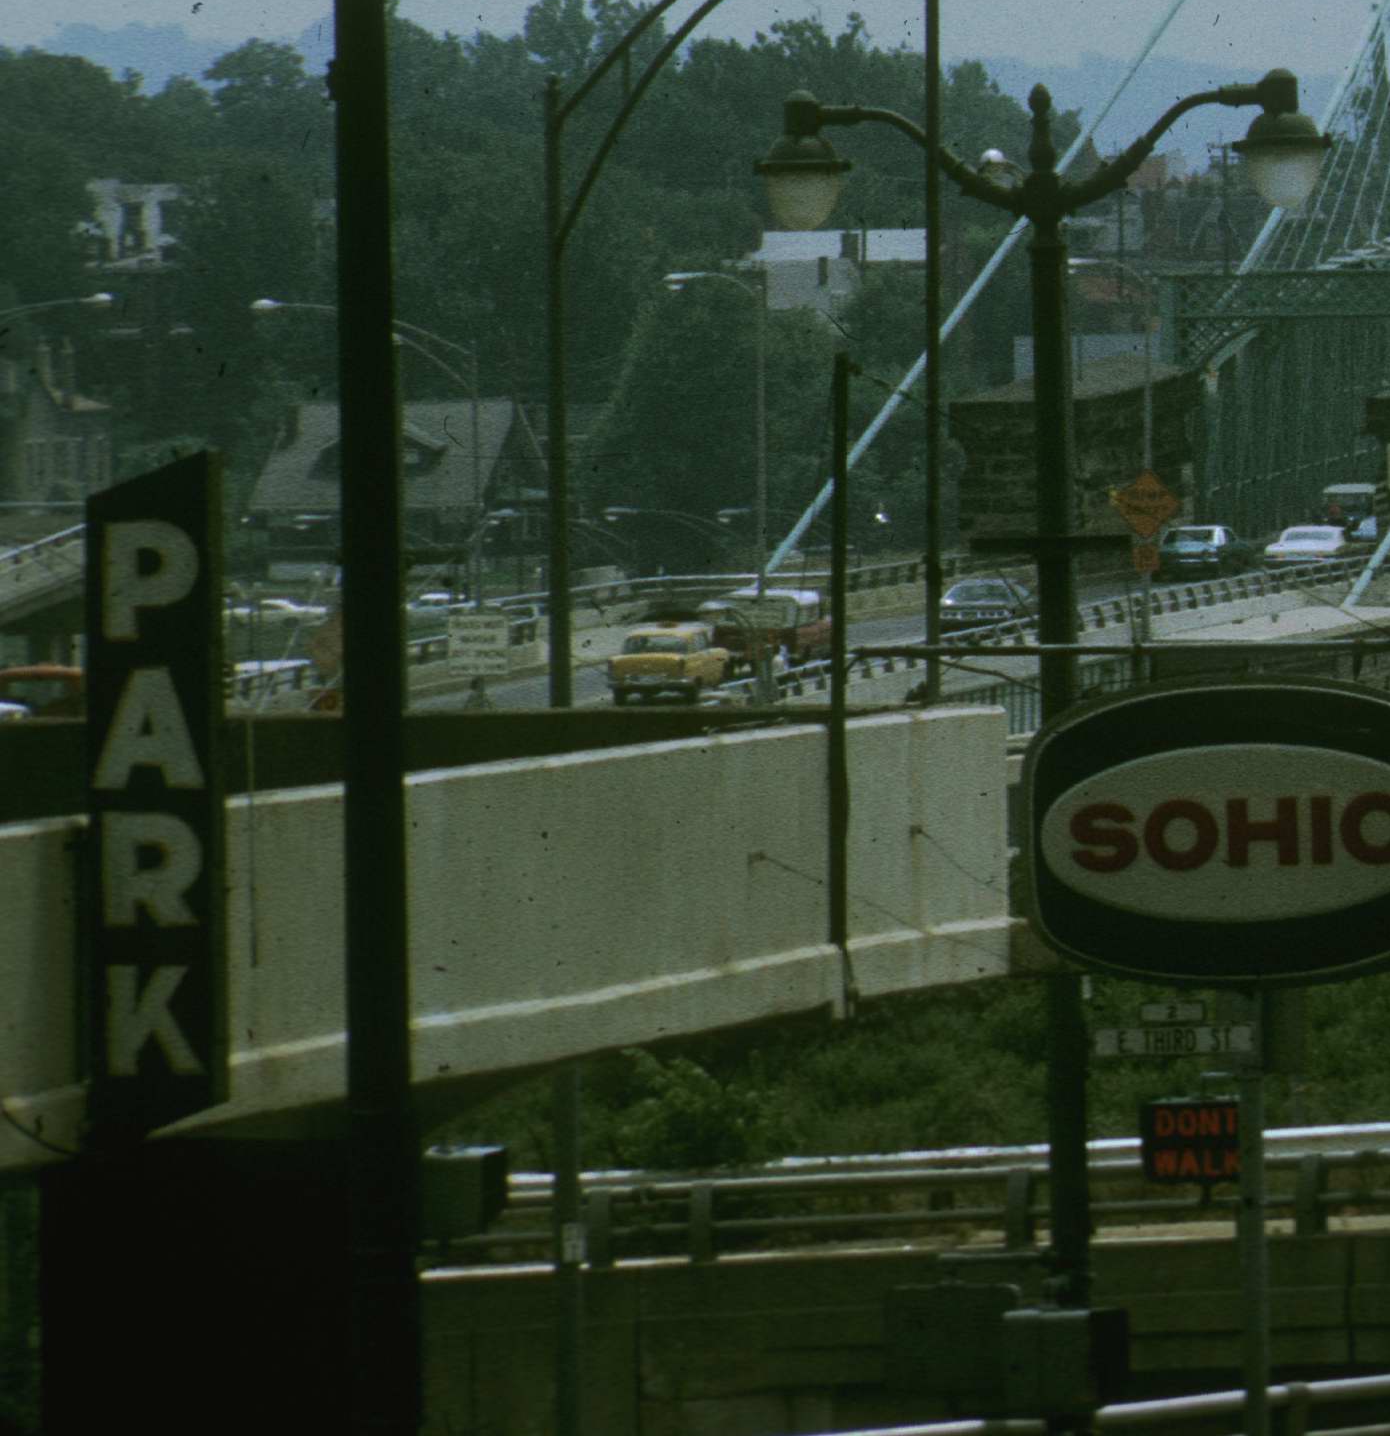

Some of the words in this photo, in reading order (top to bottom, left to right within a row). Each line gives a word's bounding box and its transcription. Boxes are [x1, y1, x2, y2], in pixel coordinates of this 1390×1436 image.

[92, 520, 206, 1076] PARK
[1118, 1030, 1131, 1053] E
[1144, 1028, 1197, 1052] THIRD
[1210, 1027, 1232, 1052] ST
[1154, 1107, 1239, 1138] DONT
[1153, 1148, 1242, 1177] WALK
